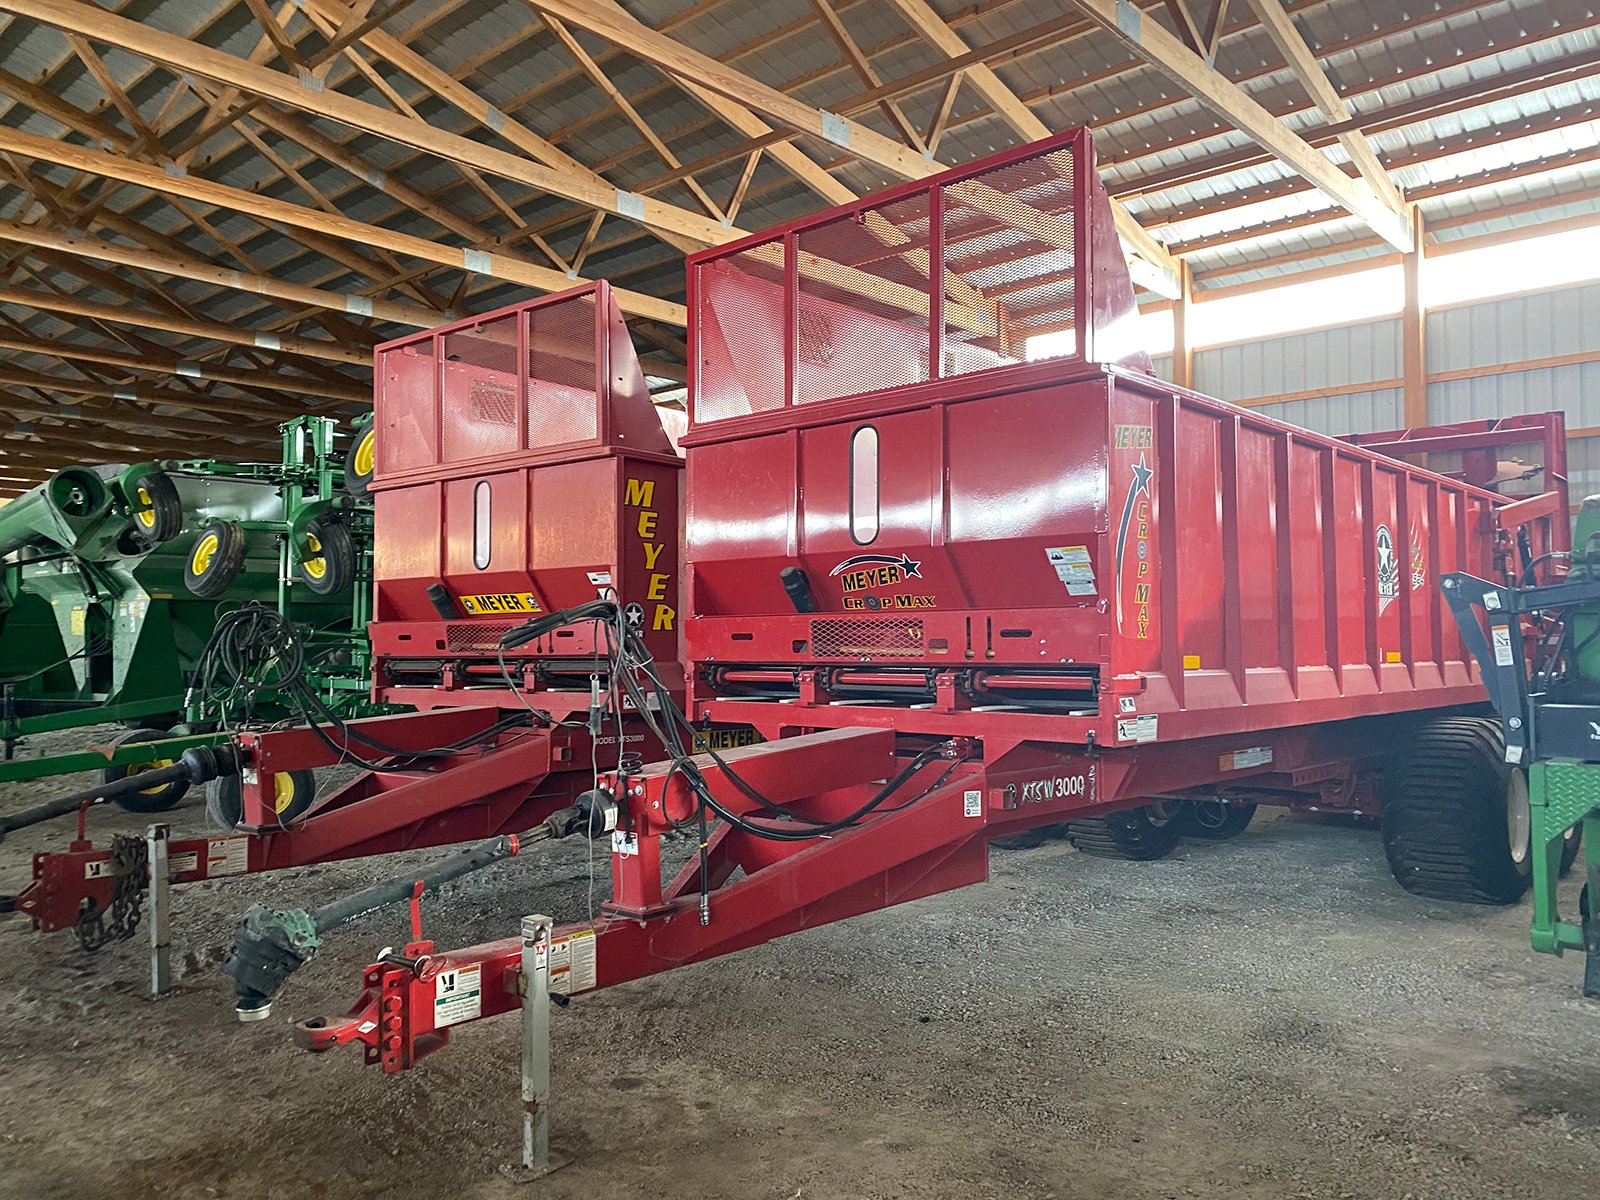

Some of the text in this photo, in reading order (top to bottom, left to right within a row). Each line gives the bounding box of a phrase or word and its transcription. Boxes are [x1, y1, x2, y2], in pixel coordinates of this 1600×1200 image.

[624, 478, 676, 631] MEYER
[841, 565, 900, 592] MEYER
[475, 594, 525, 611] MEYER
[709, 729, 754, 749] MEYER
